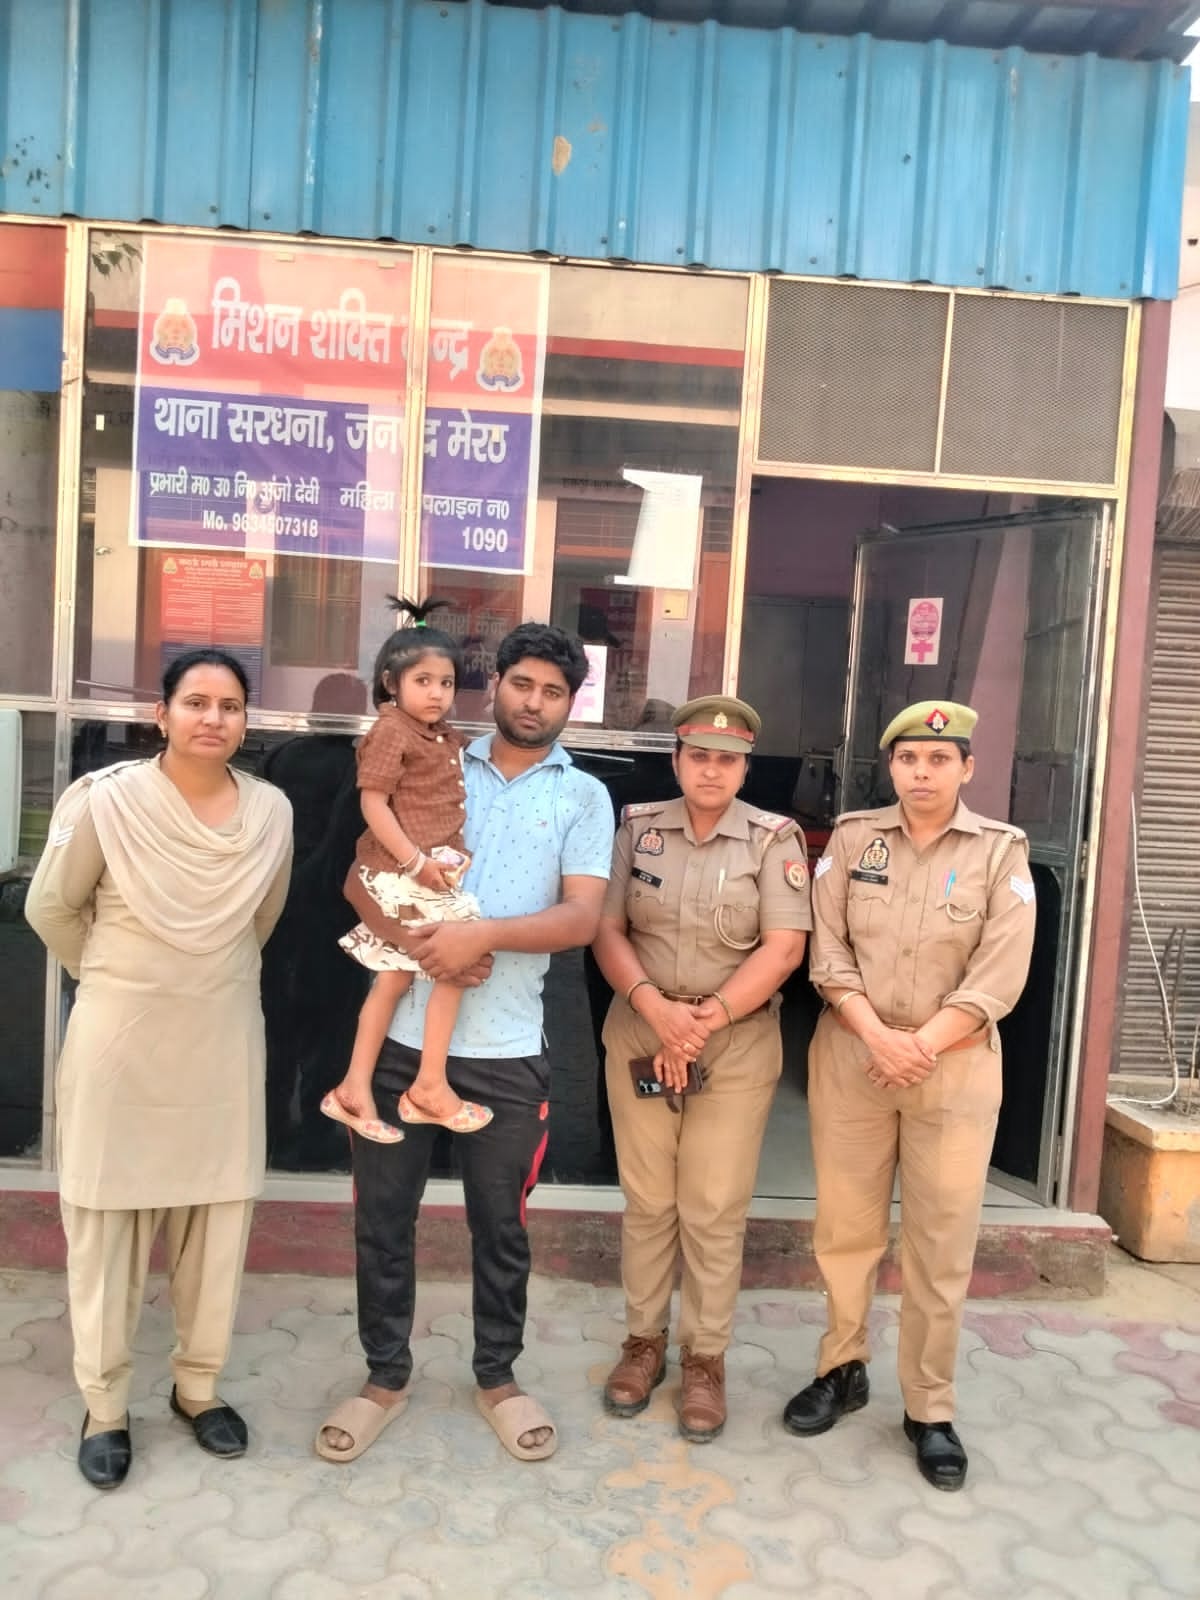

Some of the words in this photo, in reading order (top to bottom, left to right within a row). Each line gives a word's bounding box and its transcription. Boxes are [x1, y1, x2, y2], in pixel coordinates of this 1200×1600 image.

[211, 276, 303, 356] मिशन
[309, 287, 393, 364] शक्ति
[154, 397, 221, 440] थाना
[228, 402, 334, 454] सरधना,
[345, 412, 441, 455] जनद
[447, 405, 510, 464] मेरठ
[150, 465, 187, 496] प्रभारी
[294, 476, 320, 504] देवी
[339, 480, 394, 512] महिला
[203, 509, 228, 529] Mo.
[462, 526, 508, 552] 1090
